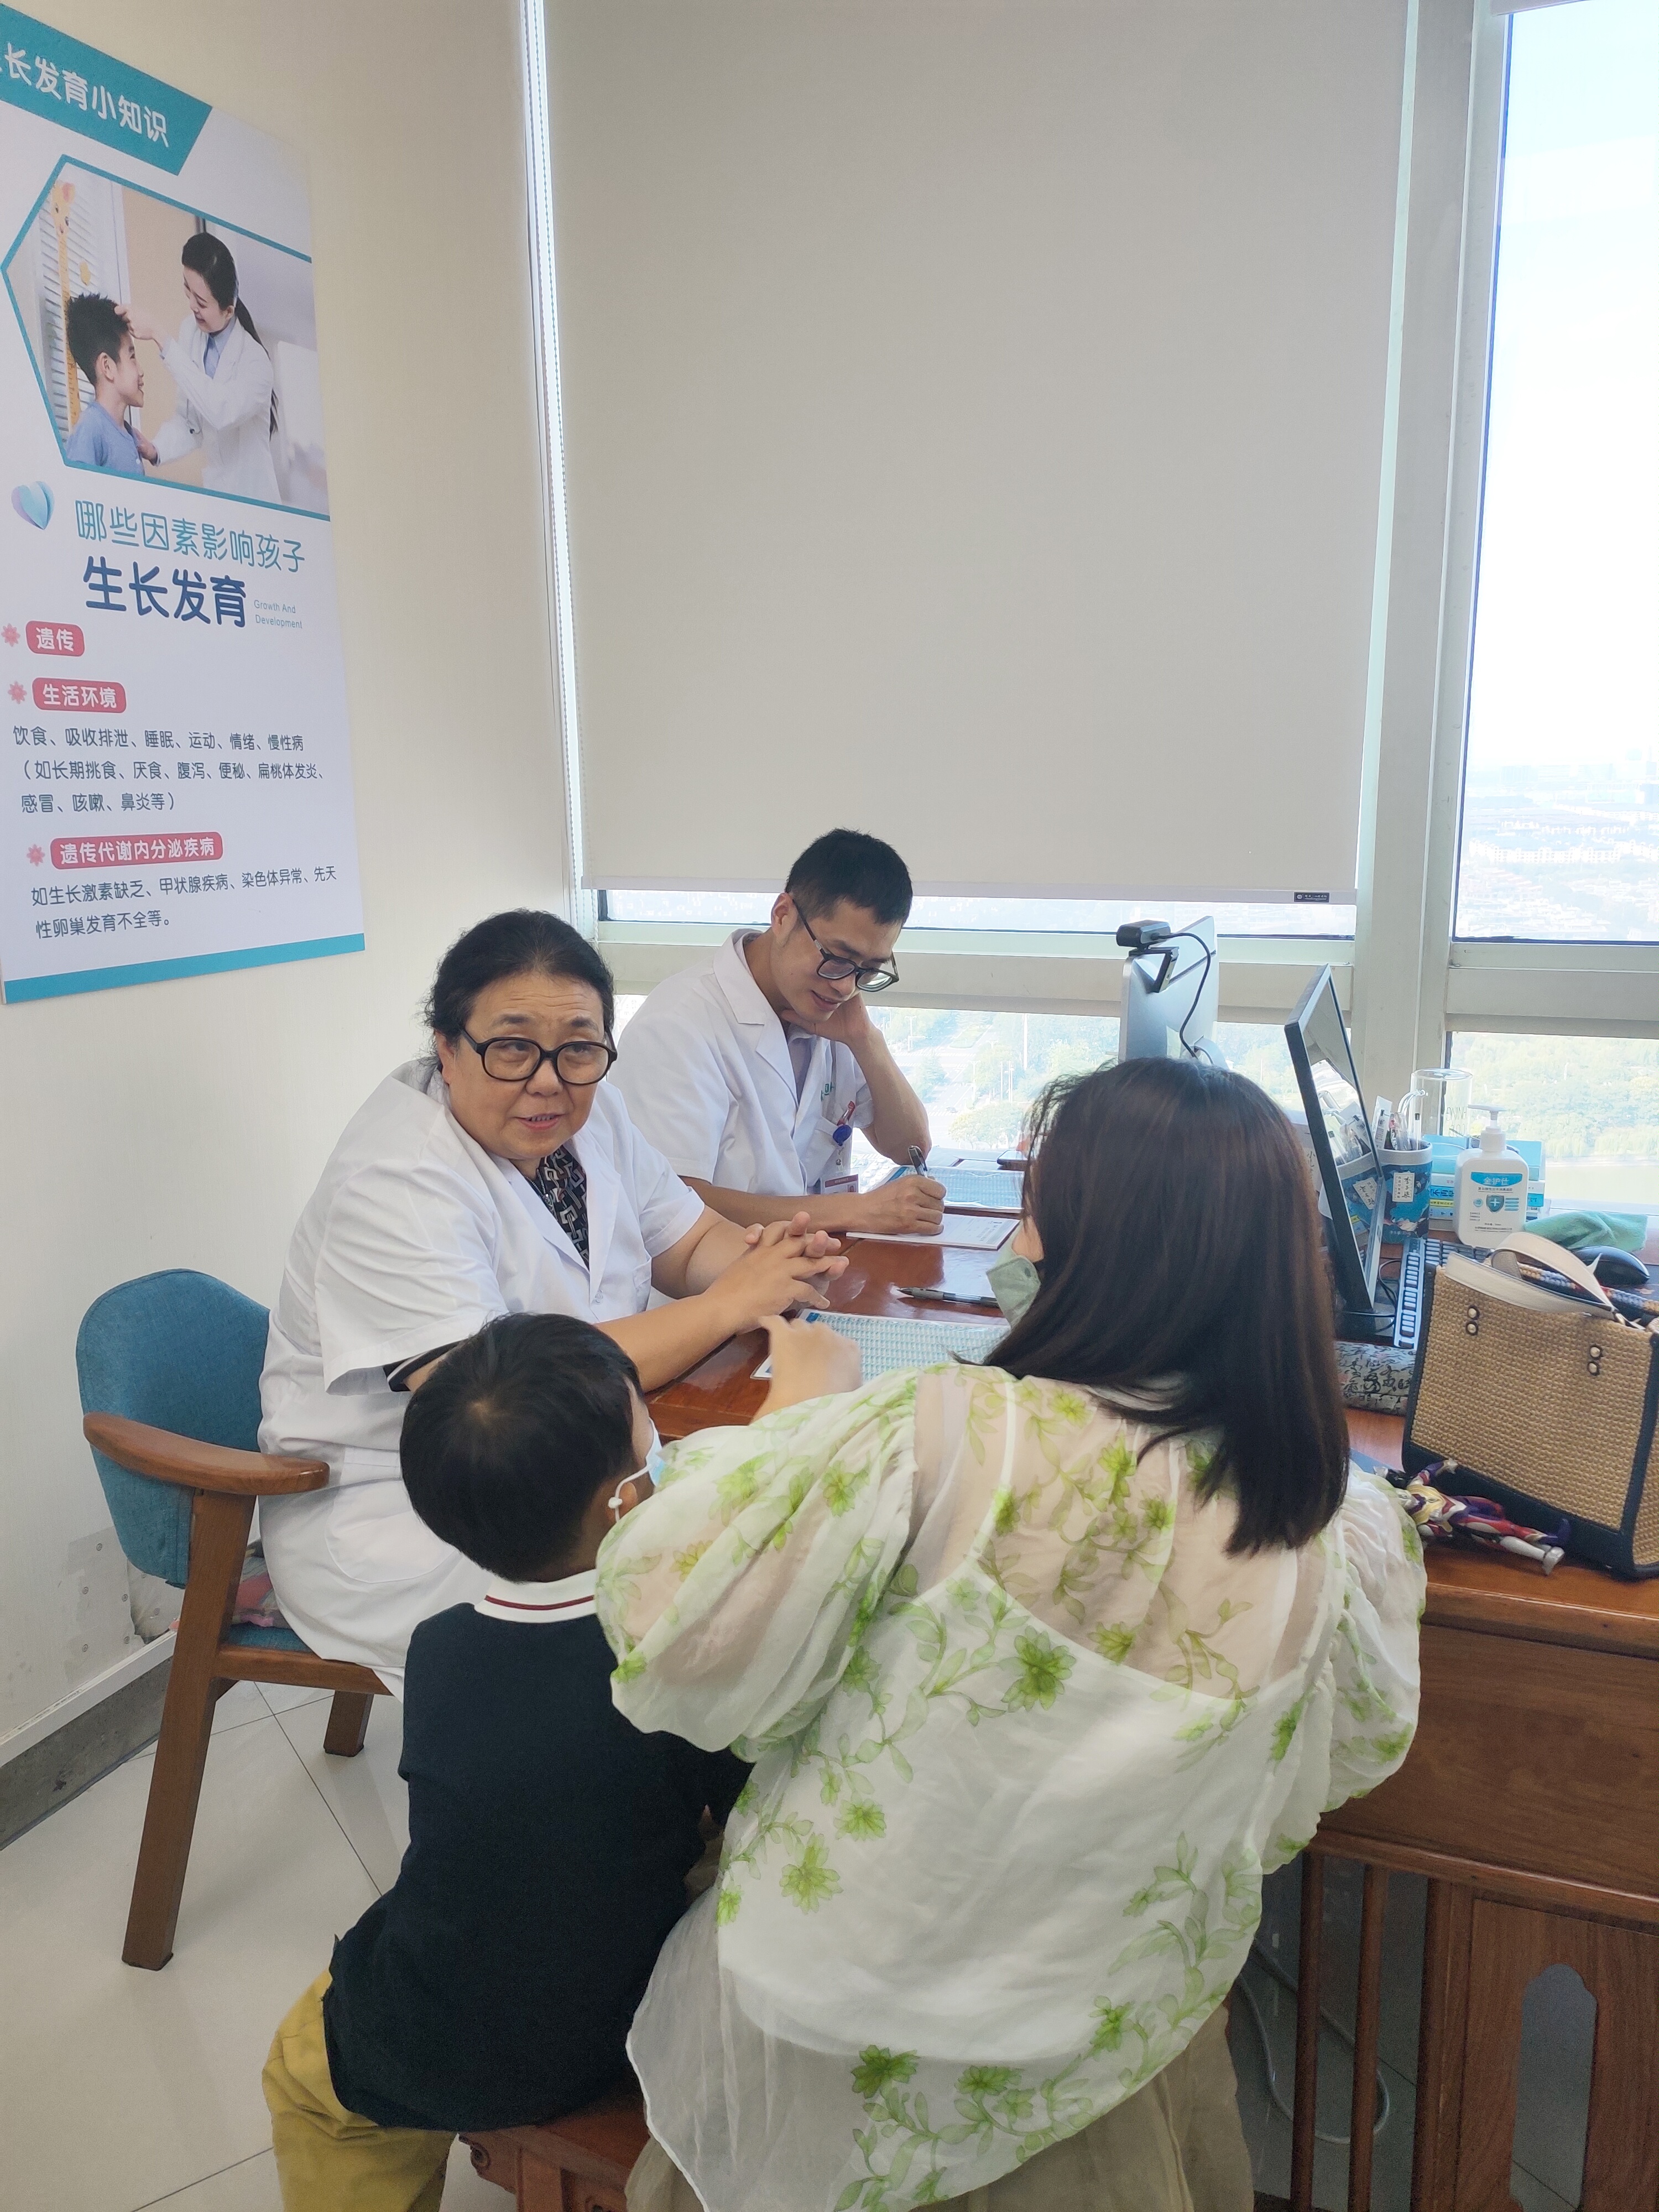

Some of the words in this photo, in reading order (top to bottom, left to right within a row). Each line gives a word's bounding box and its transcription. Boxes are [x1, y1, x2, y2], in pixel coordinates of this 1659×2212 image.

[0, 43, 169, 148] 长发育小知识
[75, 499, 305, 573] 哪些因素影响孩子
[83, 556, 247, 628] 生长发育
[254, 599, 280, 612] Growth
[281, 602, 296, 614] And
[255, 614, 303, 629] Development
[35, 627, 75, 653] 遗传
[42, 684, 117, 709] 生活环境
[13, 725, 304, 752] 饮食、吸收排泄、睡眠、运动、情绪、慢性病
[60, 837, 215, 865] 遗传代谢内分泌疾病
[31, 865, 337, 906] 如生长激素缺乏、甲状腺疾病、染色体异常、先天
[35, 910, 170, 940] 性卵巢发育不全等。
